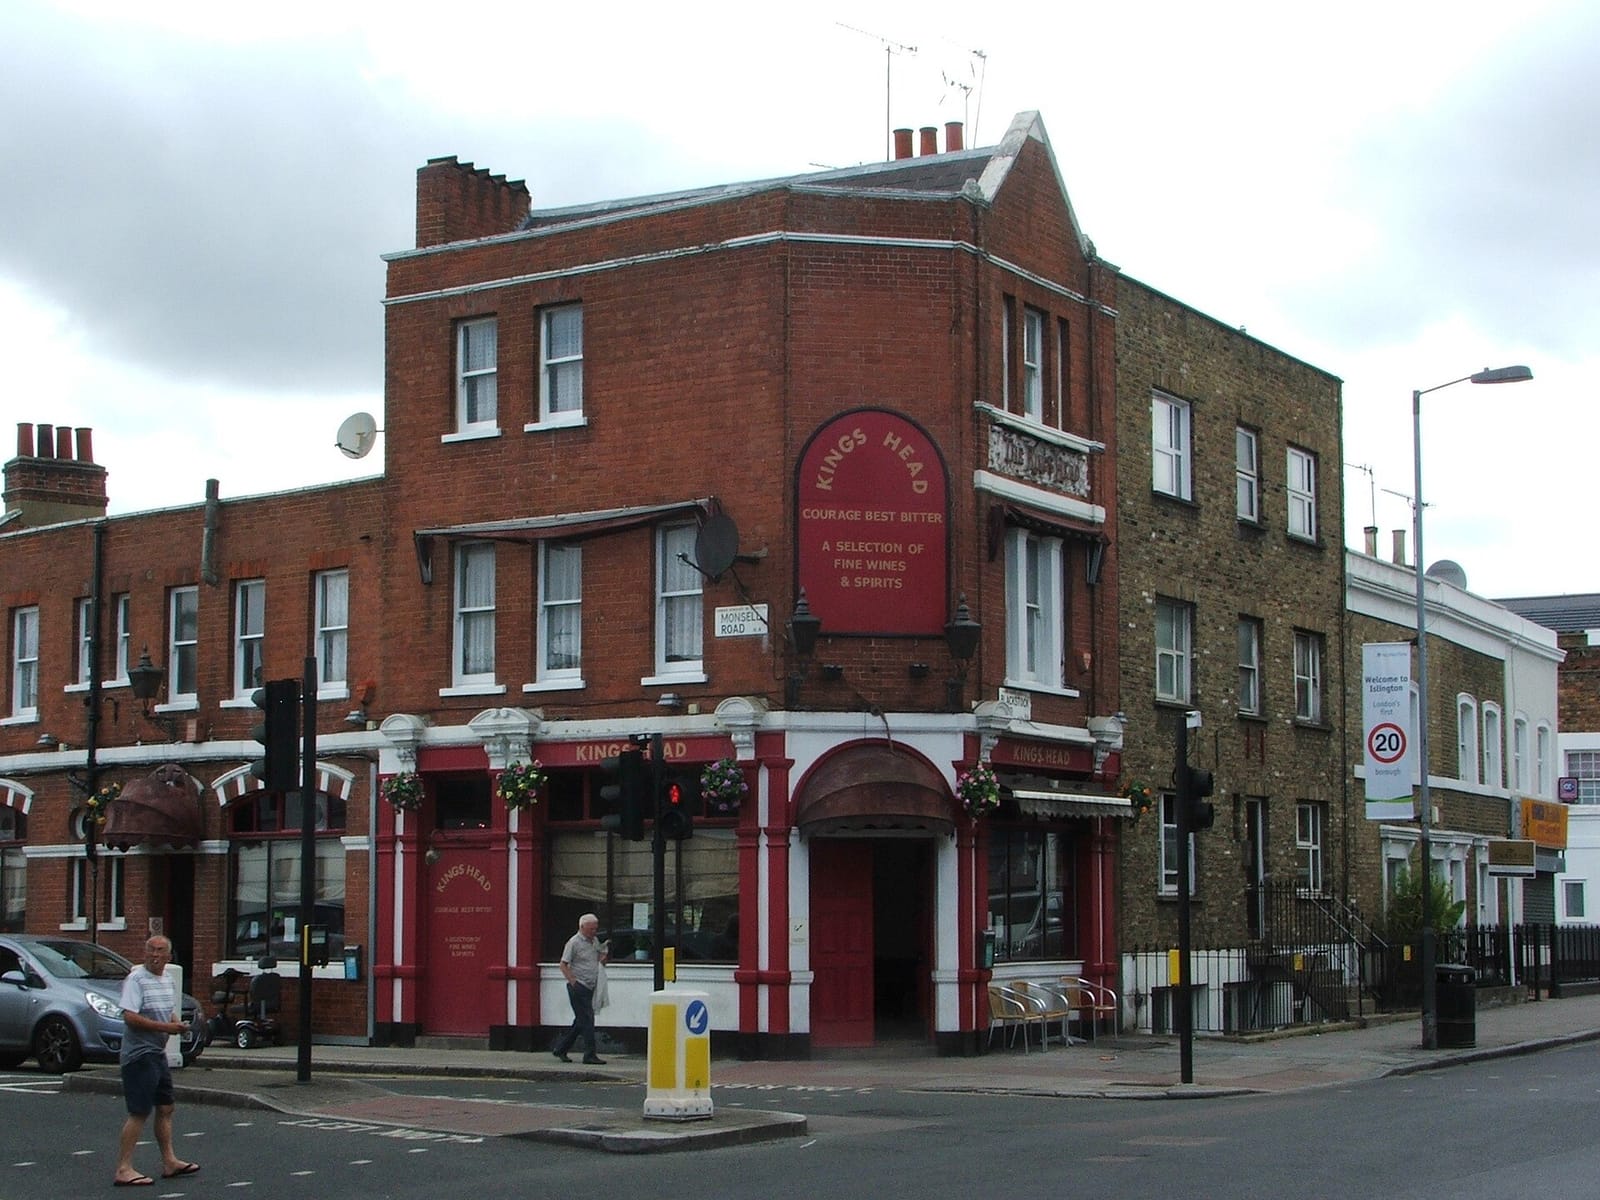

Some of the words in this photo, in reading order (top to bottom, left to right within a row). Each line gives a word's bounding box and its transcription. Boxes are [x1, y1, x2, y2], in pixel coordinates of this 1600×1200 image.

[815, 428, 868, 491] KINGS
[883, 431, 929, 494] HEAD
[803, 508, 861, 521] COURAGE
[865, 511, 896, 522] BEST
[900, 512, 943, 524] BITTER
[822, 541, 830, 551] A
[836, 541, 903, 553] SELECTION
[908, 544, 925, 554] OF
[834, 558, 863, 570] FINE
[866, 559, 906, 572] WINES
[841, 577, 850, 588] &
[854, 577, 903, 589] SPIRITS
[721, 624, 745, 634] ROAD
[1365, 675, 1398, 684] Welcome
[1370, 685, 1403, 694] Islington
[1375, 733, 1400, 752] 20
[640, 742, 687, 760] HAD
[1013, 745, 1042, 762] KINGS
[1045, 749, 1070, 765] HEAD
[437, 864, 464, 892] KINGS
[466, 864, 491, 892] HEAD
